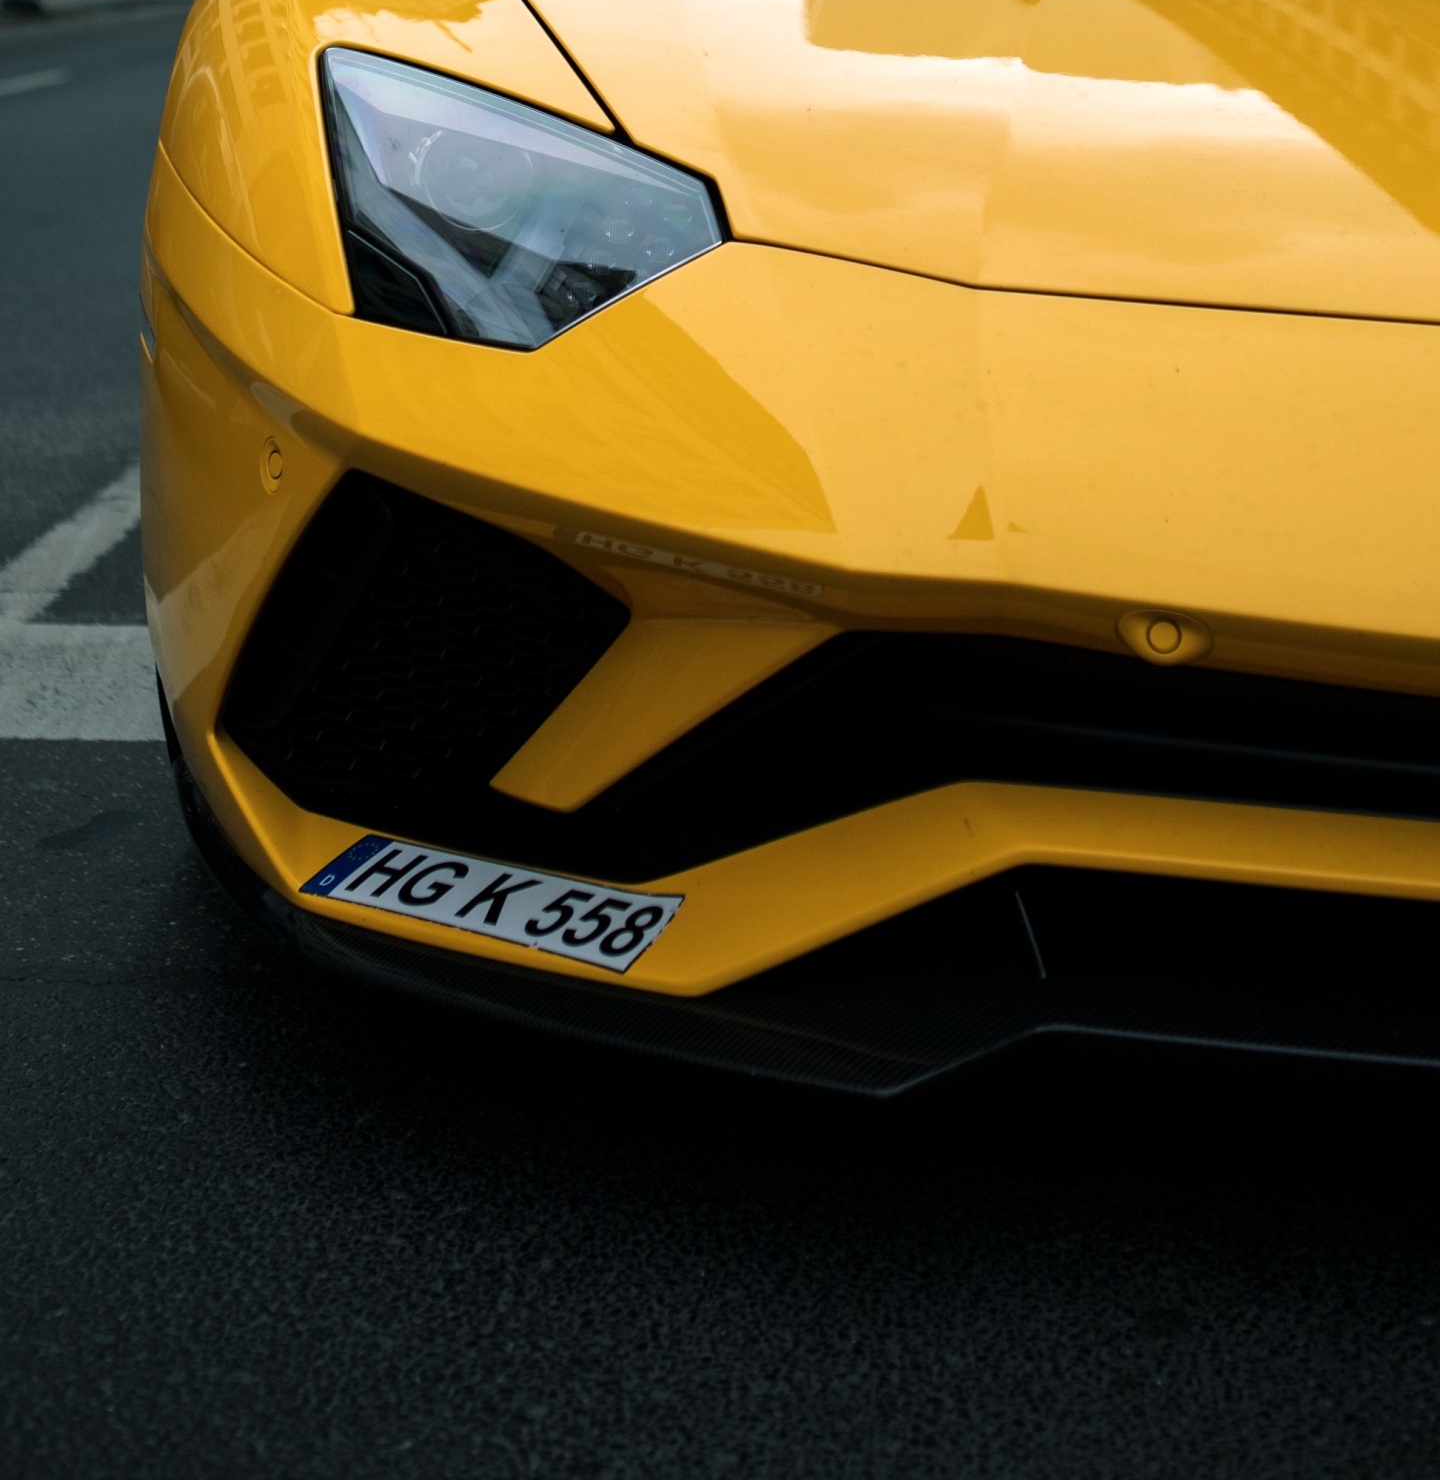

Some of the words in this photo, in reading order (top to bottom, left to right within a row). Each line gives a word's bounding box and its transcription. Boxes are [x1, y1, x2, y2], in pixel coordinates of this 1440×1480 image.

[319, 874, 335, 887] D
[344, 849, 469, 907] HG
[454, 873, 545, 927] K
[524, 889, 664, 958] 558
